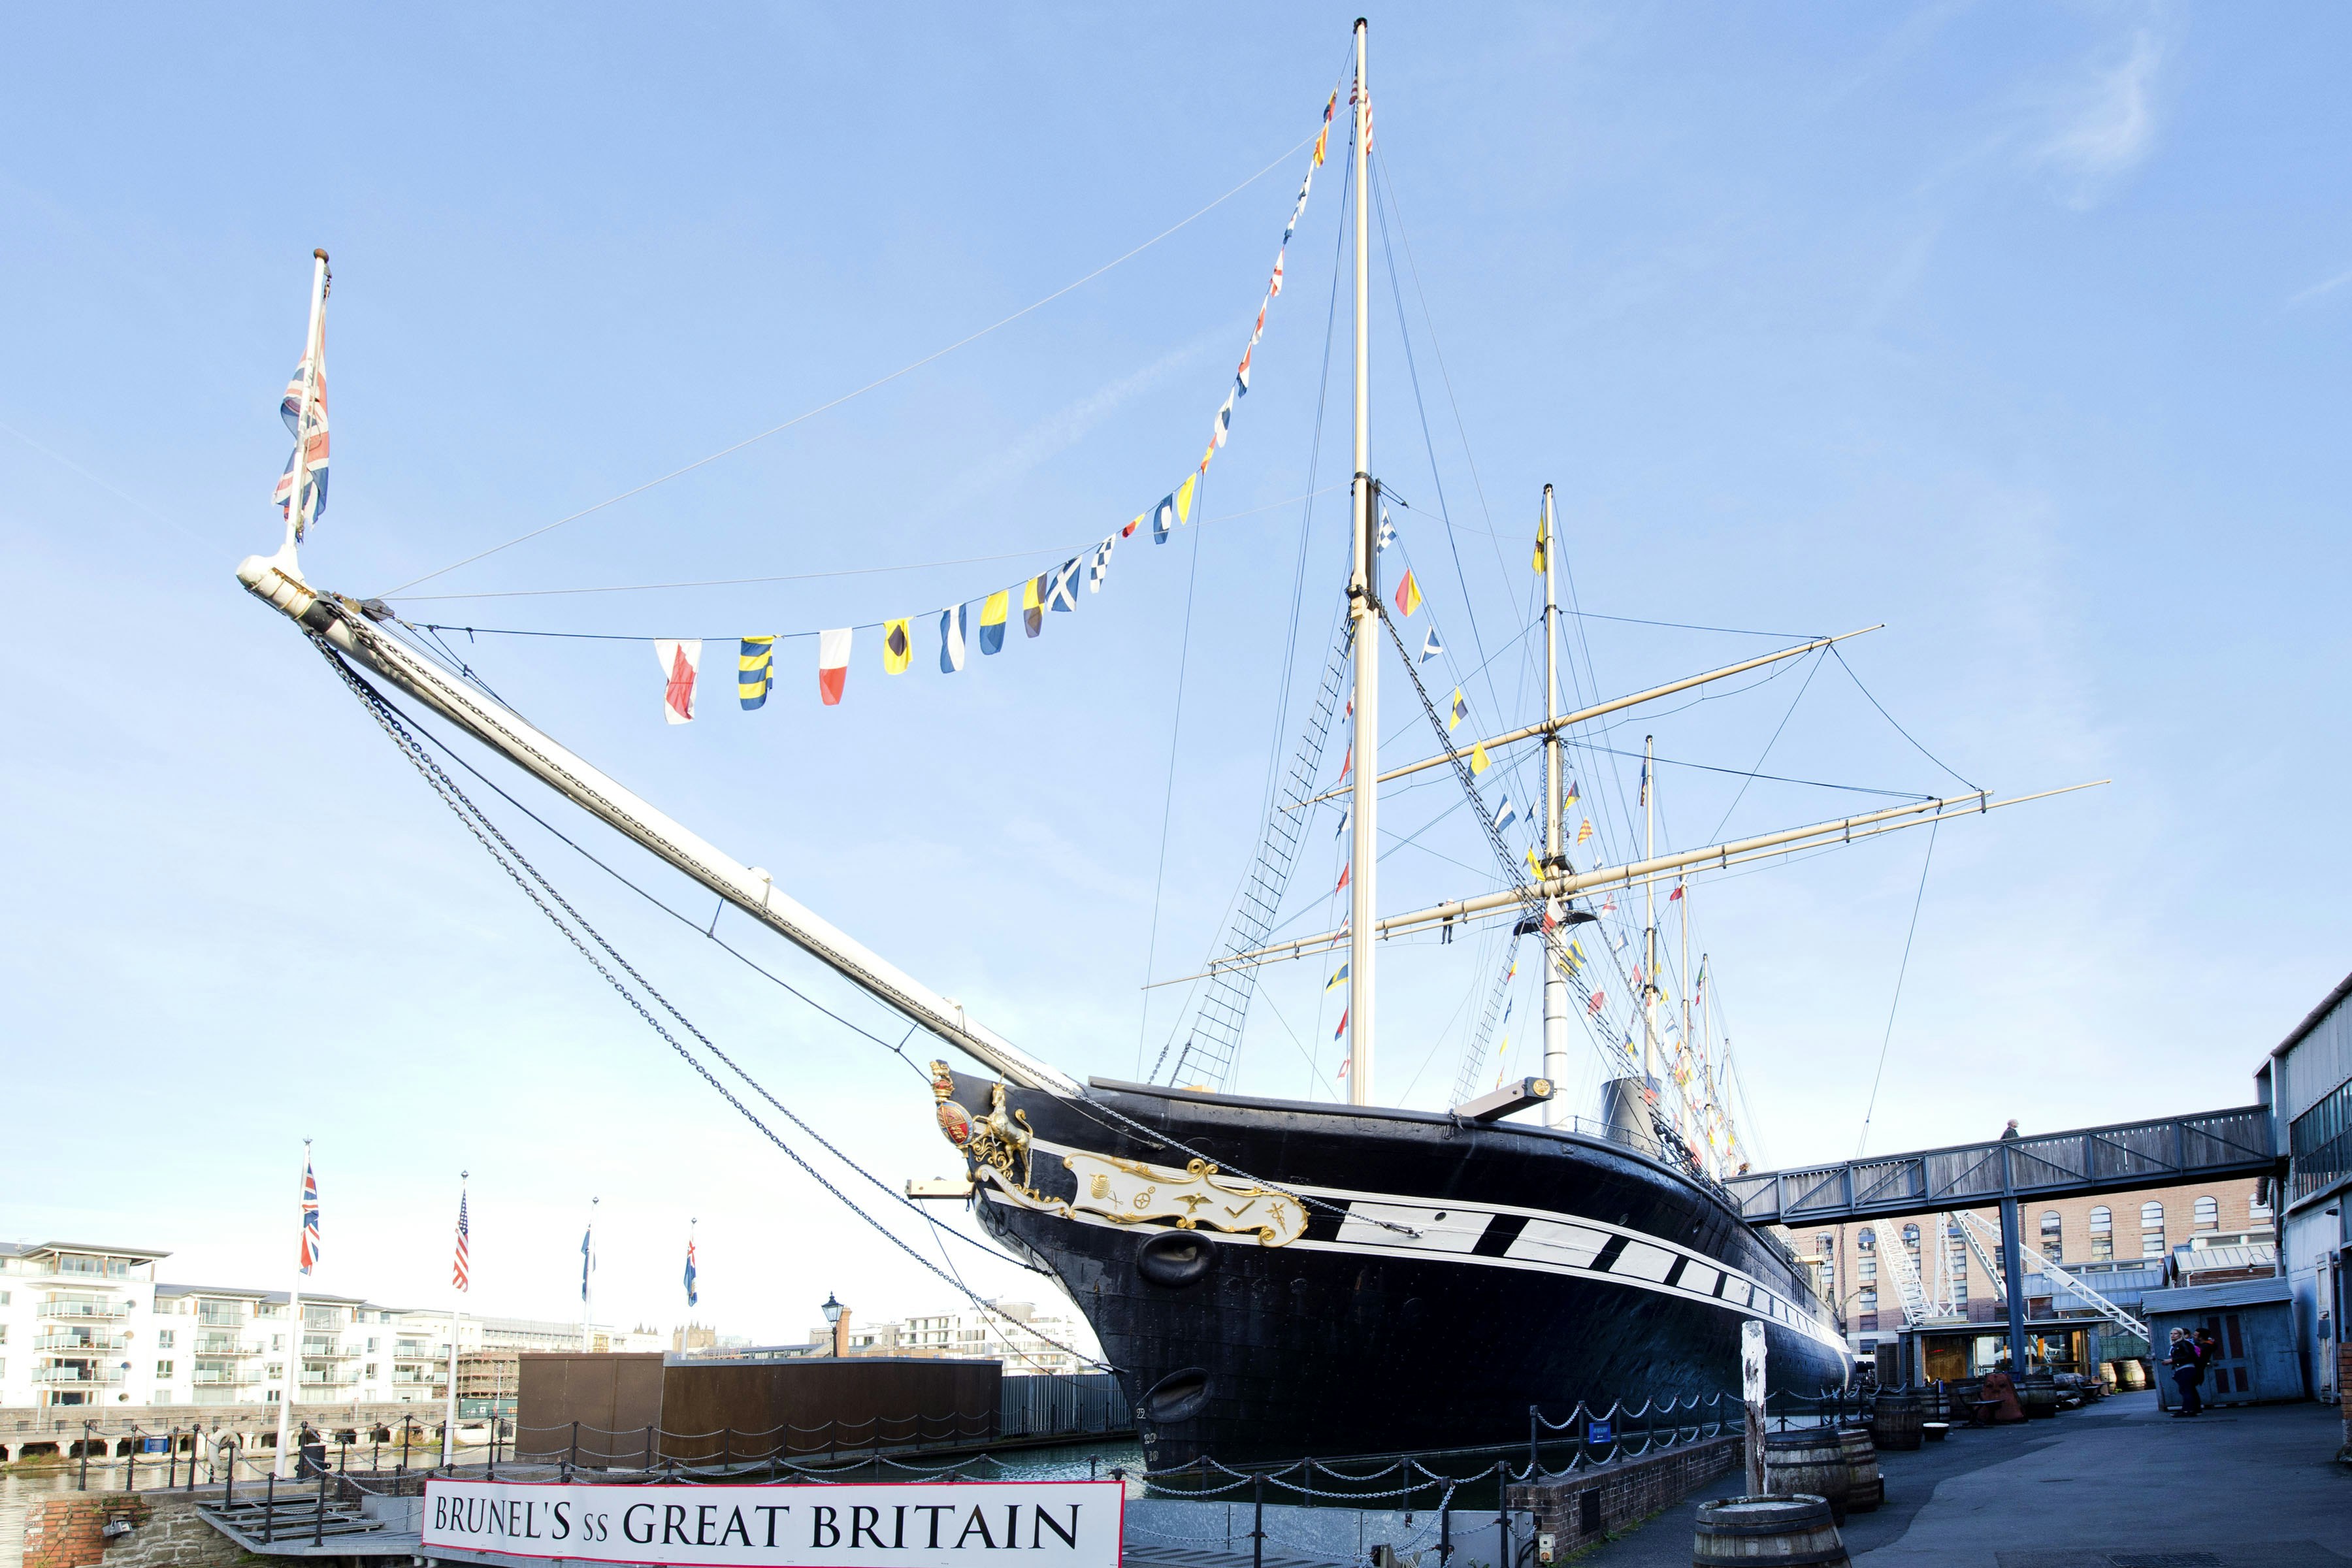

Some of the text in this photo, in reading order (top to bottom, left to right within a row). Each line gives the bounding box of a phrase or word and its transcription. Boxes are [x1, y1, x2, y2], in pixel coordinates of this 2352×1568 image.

[1000, 1178, 1018, 1197] MON
[1144, 1432, 1157, 1444] 20
[434, 1495, 571, 1541] BRUNEL'S
[623, 1503, 791, 1547] GREAT
[809, 1503, 1084, 1550] BRITAIN
